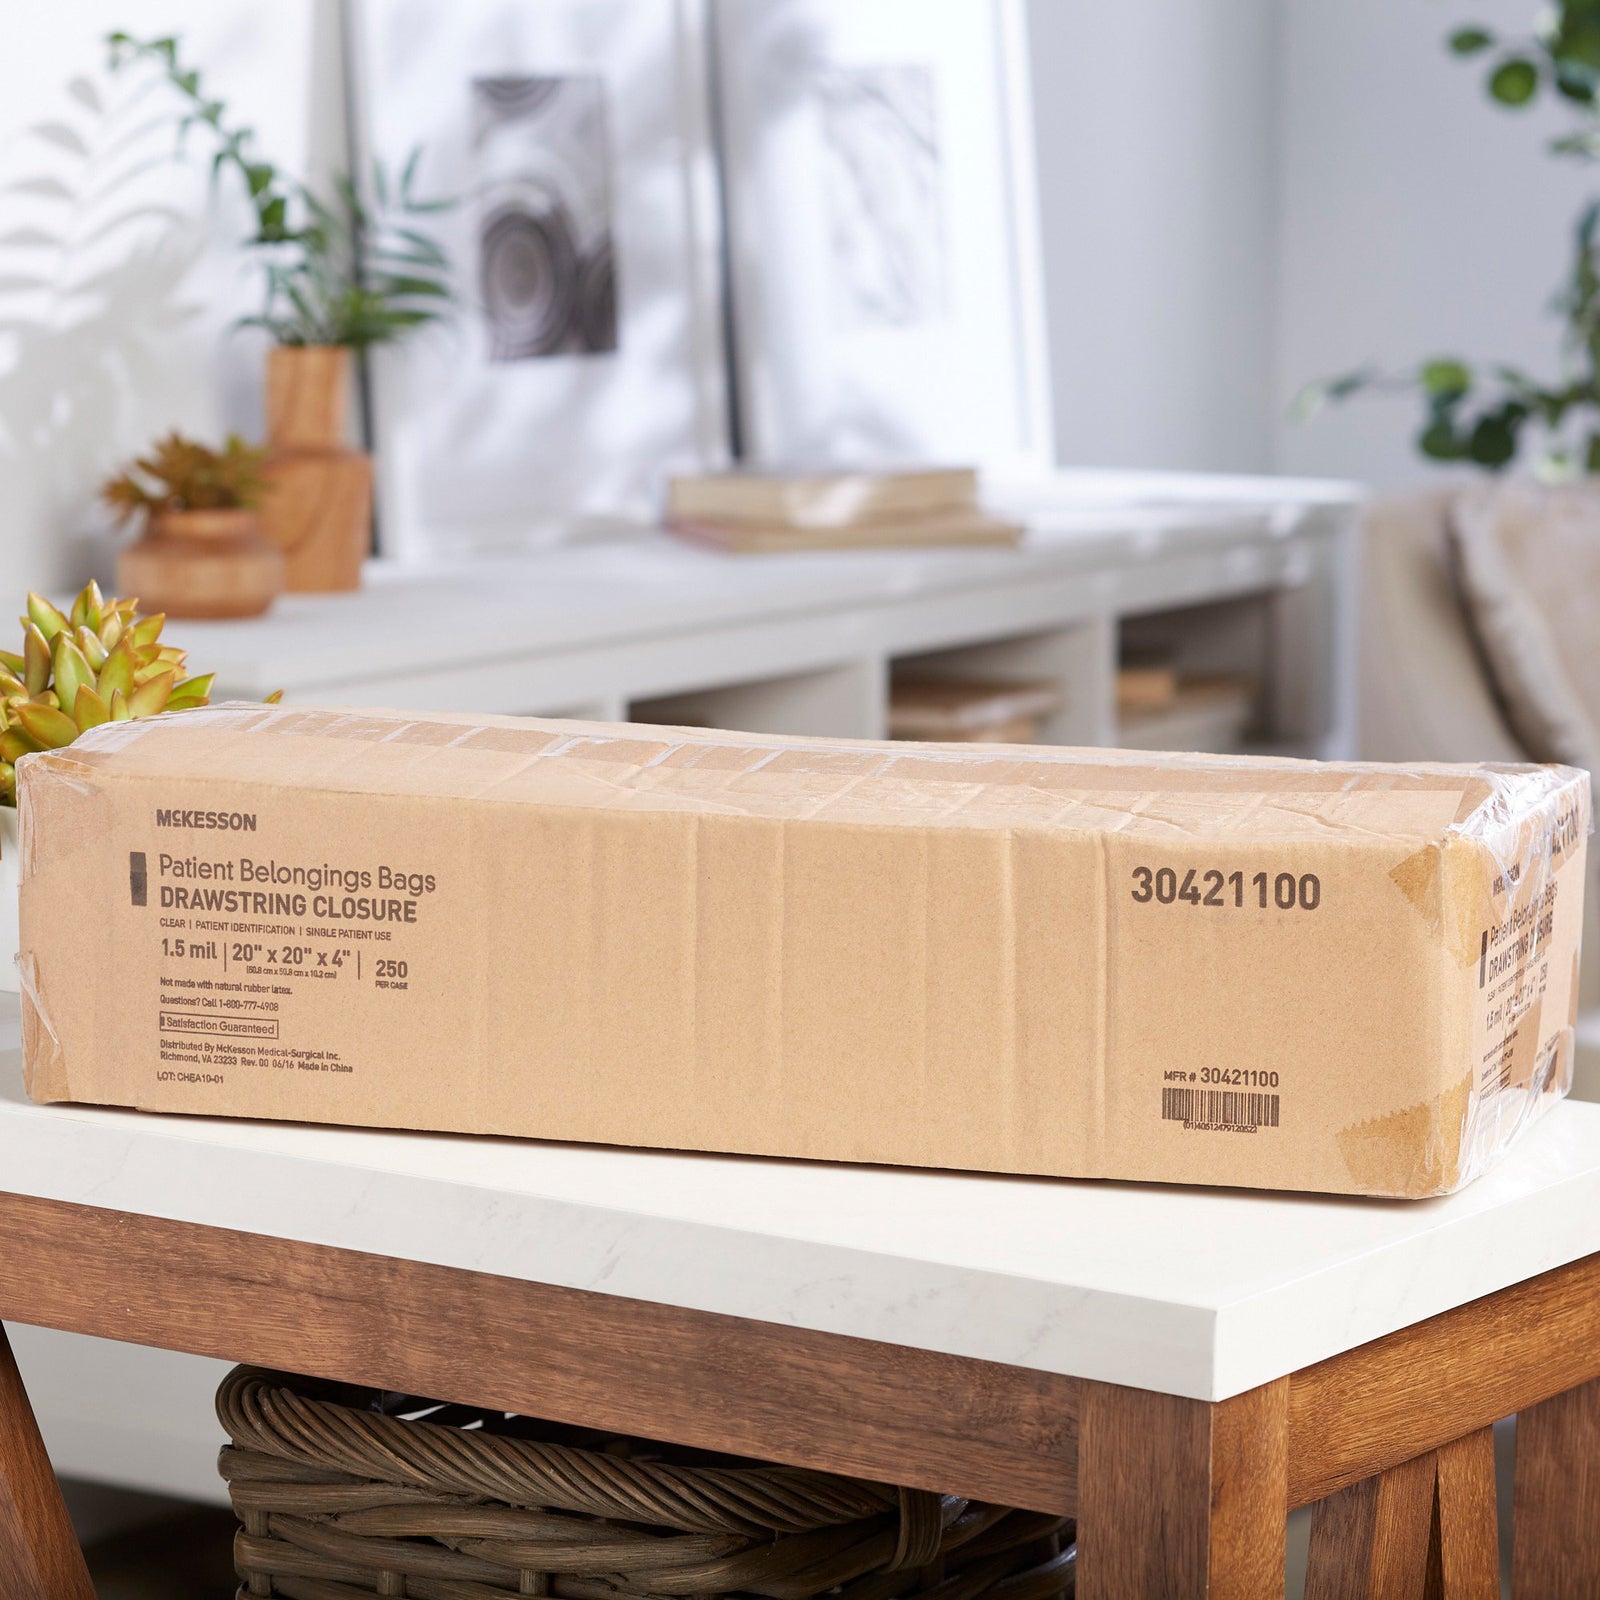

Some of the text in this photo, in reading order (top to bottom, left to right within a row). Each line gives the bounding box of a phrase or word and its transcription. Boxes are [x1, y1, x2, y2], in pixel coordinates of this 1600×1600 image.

[157, 809, 256, 831] McKESSON
[160, 854, 436, 897] Patient Belongings Bags
[1131, 866, 1320, 910] 30421100
[161, 886, 418, 923] DRAWSTRING CLOSURE
[160, 918, 185, 928] CLEAR
[196, 920, 295, 935] PATIENT IDENTIFICATION
[306, 927, 391, 941] SINGLE PATIENT USE
[162, 938, 217, 959] 1.5 mil
[233, 943, 350, 967] 20" x 20" x 4"
[376, 960, 408, 978] 250
[160, 977, 292, 995] Not made with natural rubber latex.
[375, 980, 408, 990] PER CASE
[160, 994, 279, 1011] Questions? Call 1-800-777-4908
[167, 1017, 274, 1034] Satisfaction Guaranteed
[160, 1039, 340, 1062] Distributed By McKesson Medical-Surgical Inc.
[160, 1050, 353, 1073] Richmond, VA 23233 Rev. 00 06/16 Made in China
[157, 1071, 223, 1083] LOT: CHEA10-01
[1164, 1067, 1279, 1088] MFR # 30421100
